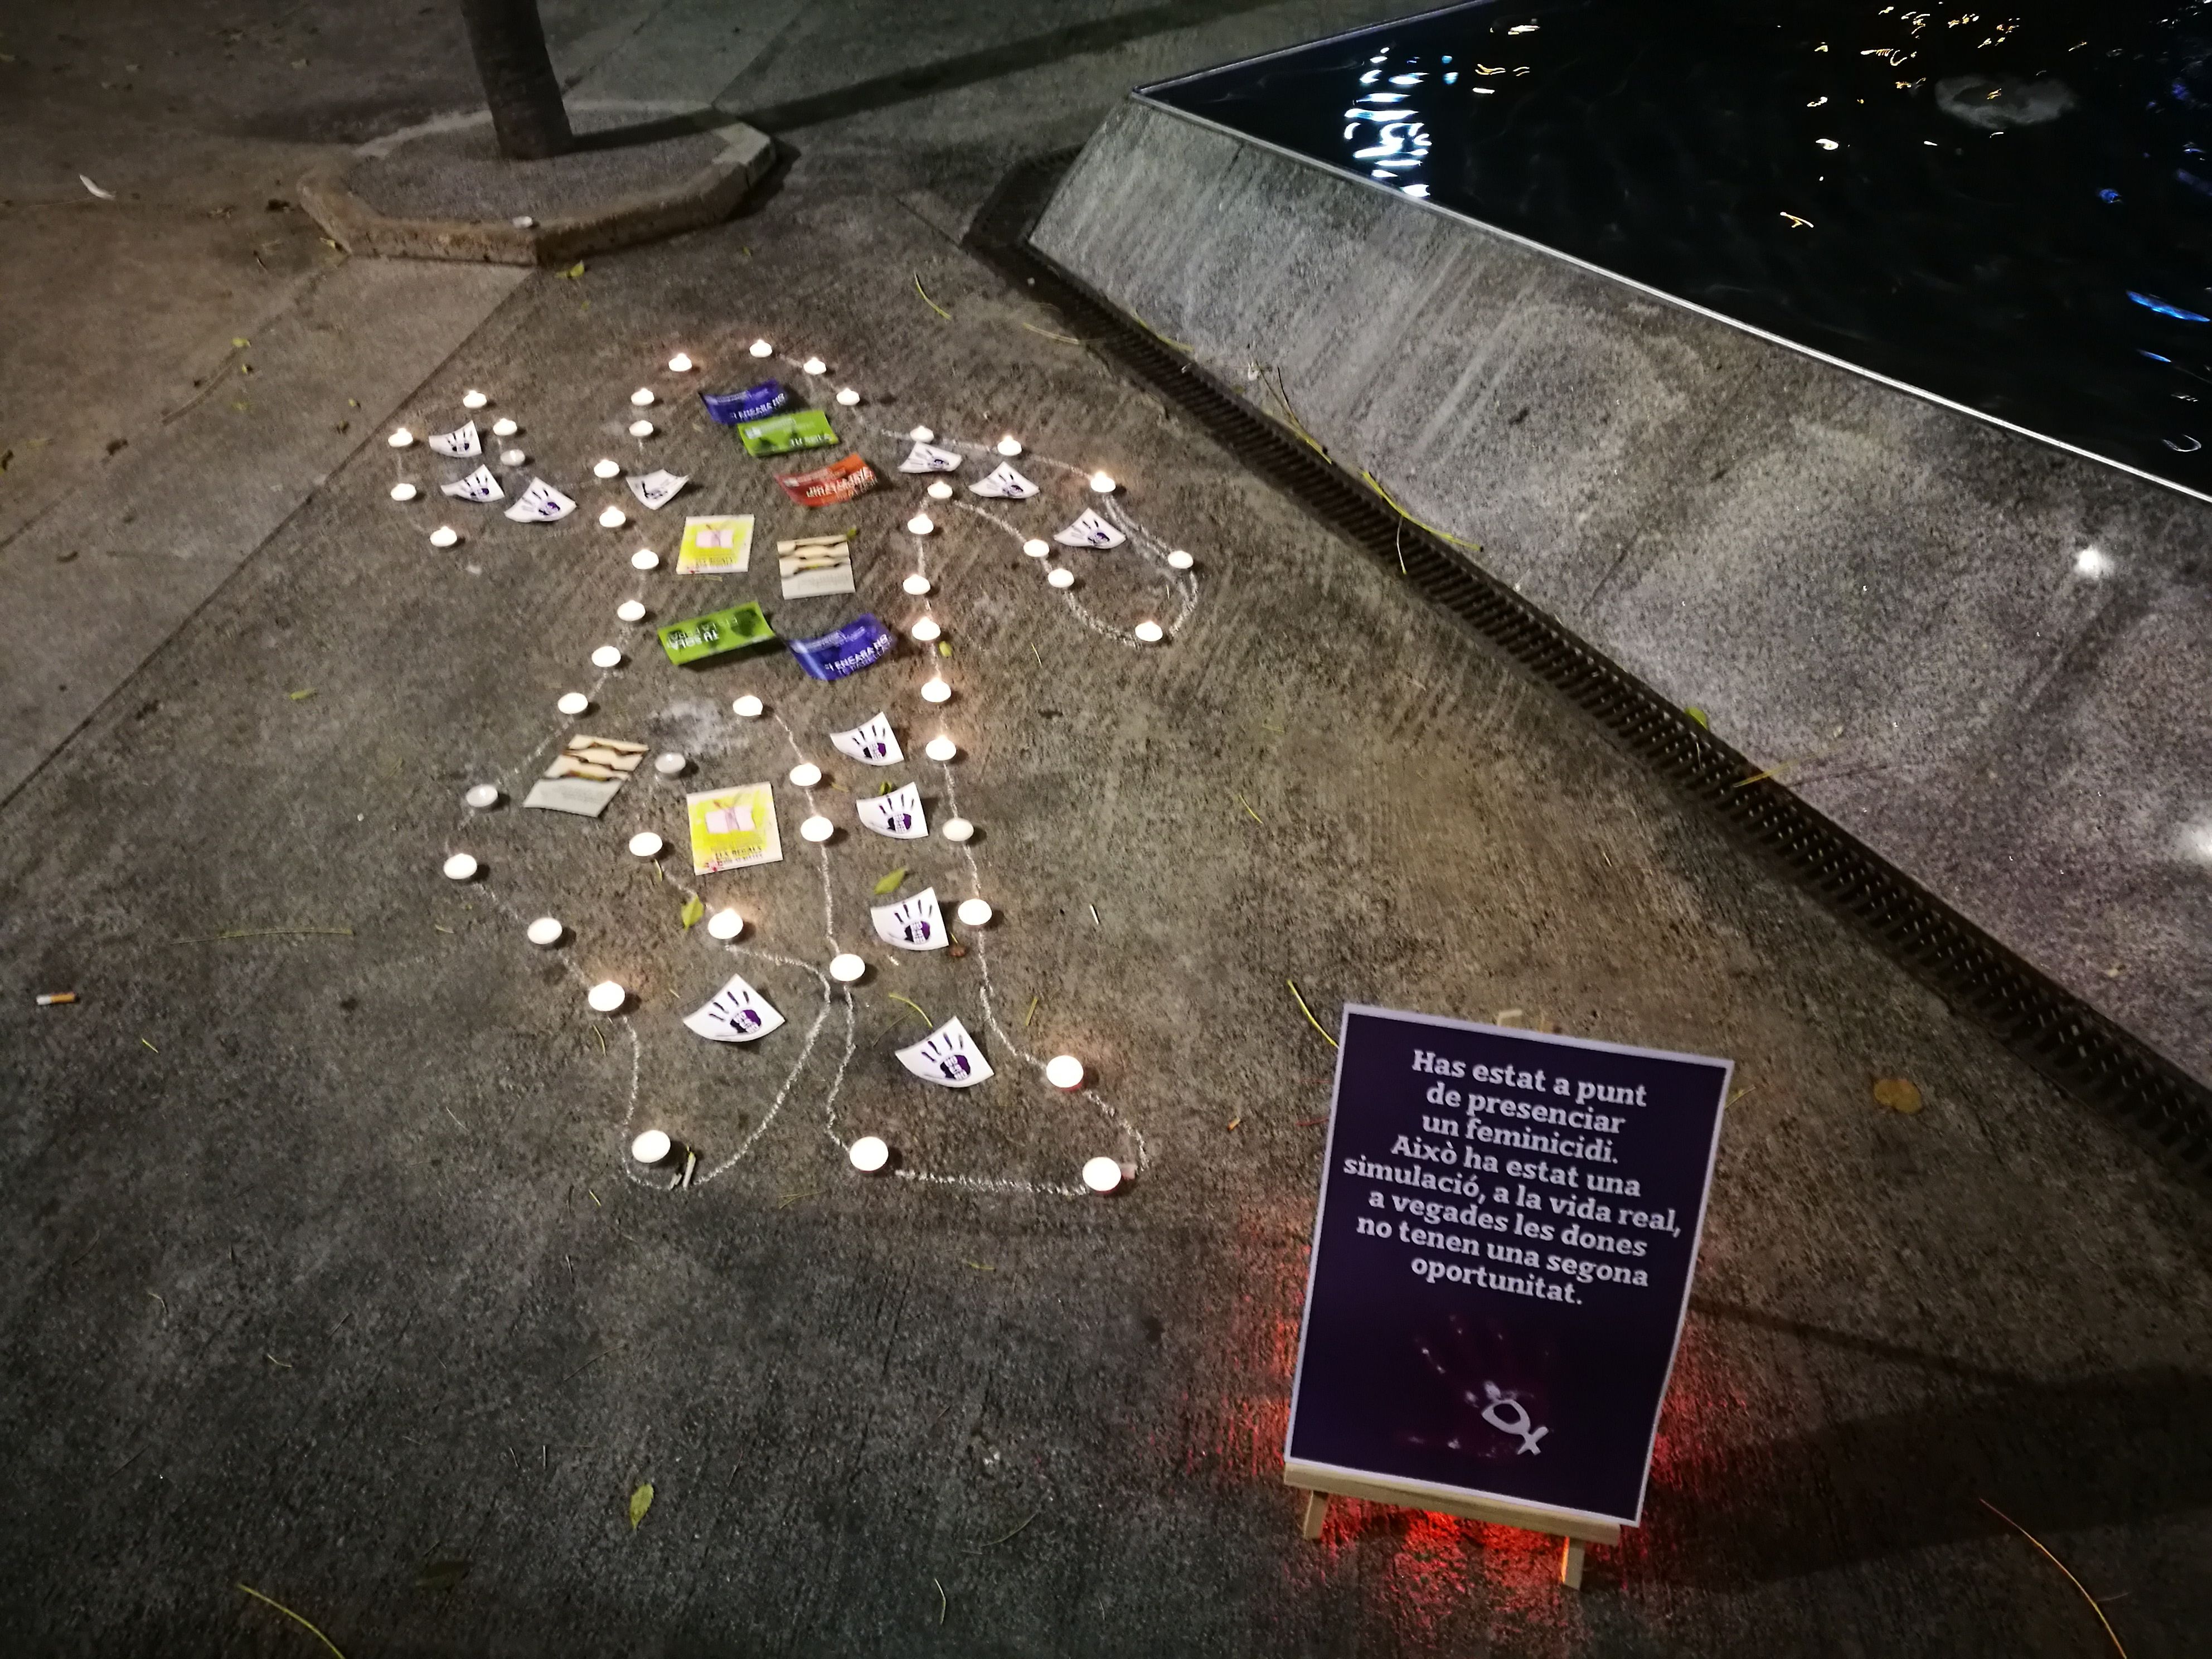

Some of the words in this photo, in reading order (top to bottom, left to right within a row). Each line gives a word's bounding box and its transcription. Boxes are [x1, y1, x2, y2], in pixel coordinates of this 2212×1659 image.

[1411, 1049, 1467, 1079] Has
[1472, 1064, 1546, 1093] estat
[1553, 1077, 1571, 1097] a
[1574, 1080, 1647, 1107] punt
[1426, 1080, 1462, 1108] de
[1464, 1093, 1627, 1135] presenciar
[1390, 1134, 1458, 1165] Això
[1463, 1144, 1499, 1174] ha
[1505, 1160, 1579, 1189] estat
[1587, 1173, 1641, 1197] una
[1422, 1114, 1459, 1138] un
[1464, 1118, 1619, 1165] feminicidi.
[1342, 1154, 1486, 1205] simulació,
[1492, 1186, 1510, 1205] a
[1515, 1183, 1542, 1211] la
[1549, 1194, 1612, 1223] vida
[1617, 1208, 1681, 1238] real,
[1368, 1191, 1385, 1209] a
[1391, 1194, 1509, 1233] vegades
[1513, 1212, 1555, 1241] les
[1560, 1223, 1648, 1257] dones
[1356, 1216, 1393, 1239] no
[1398, 1220, 1481, 1257] tenen
[1486, 1242, 1540, 1269] una
[1545, 1254, 1648, 1287] segona
[1410, 1257, 1583, 1306] oportunitat.
